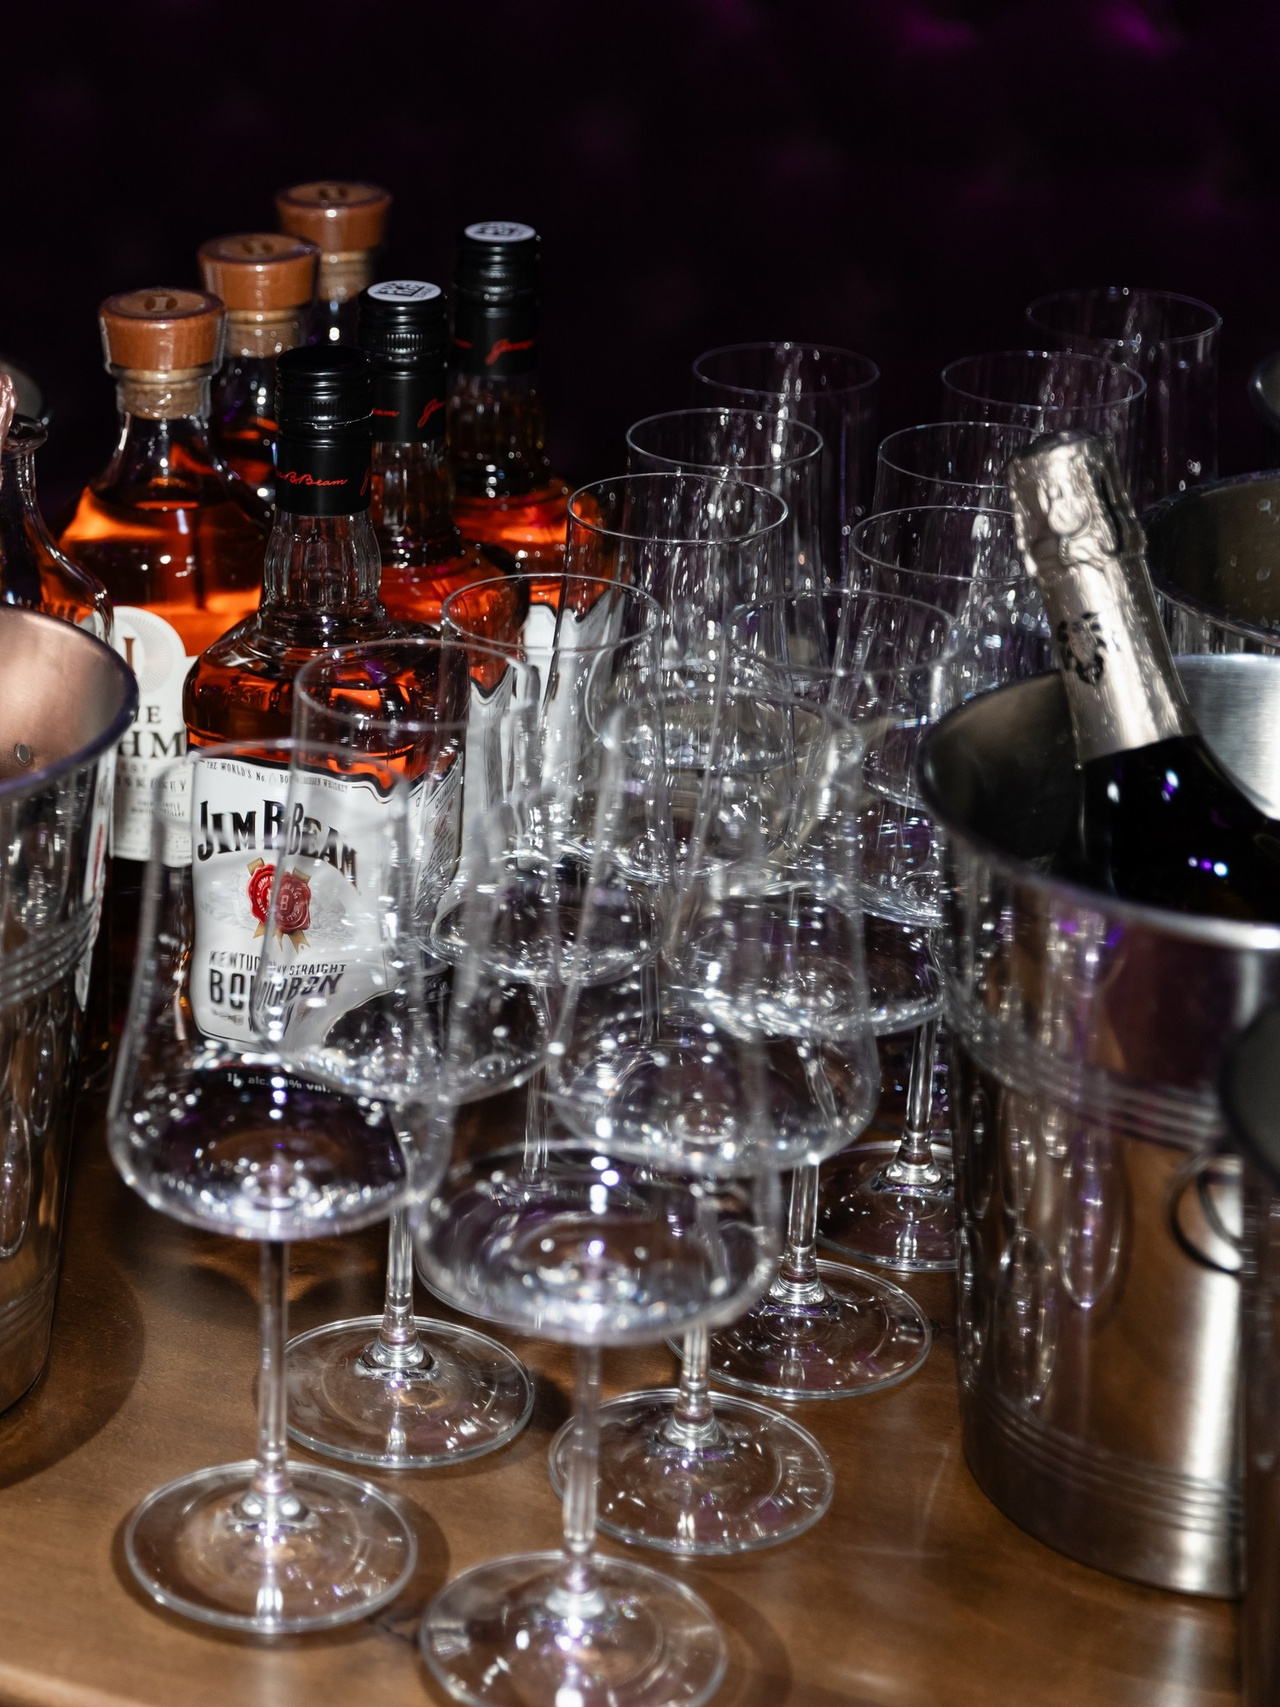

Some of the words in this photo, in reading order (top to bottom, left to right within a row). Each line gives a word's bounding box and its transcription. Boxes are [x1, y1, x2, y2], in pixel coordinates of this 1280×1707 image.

[206, 761, 218, 771] THE
[221, 762, 252, 780] WORLD'S
[197, 800, 257, 862] JIM
[288, 963, 347, 976] STRAIGHT
